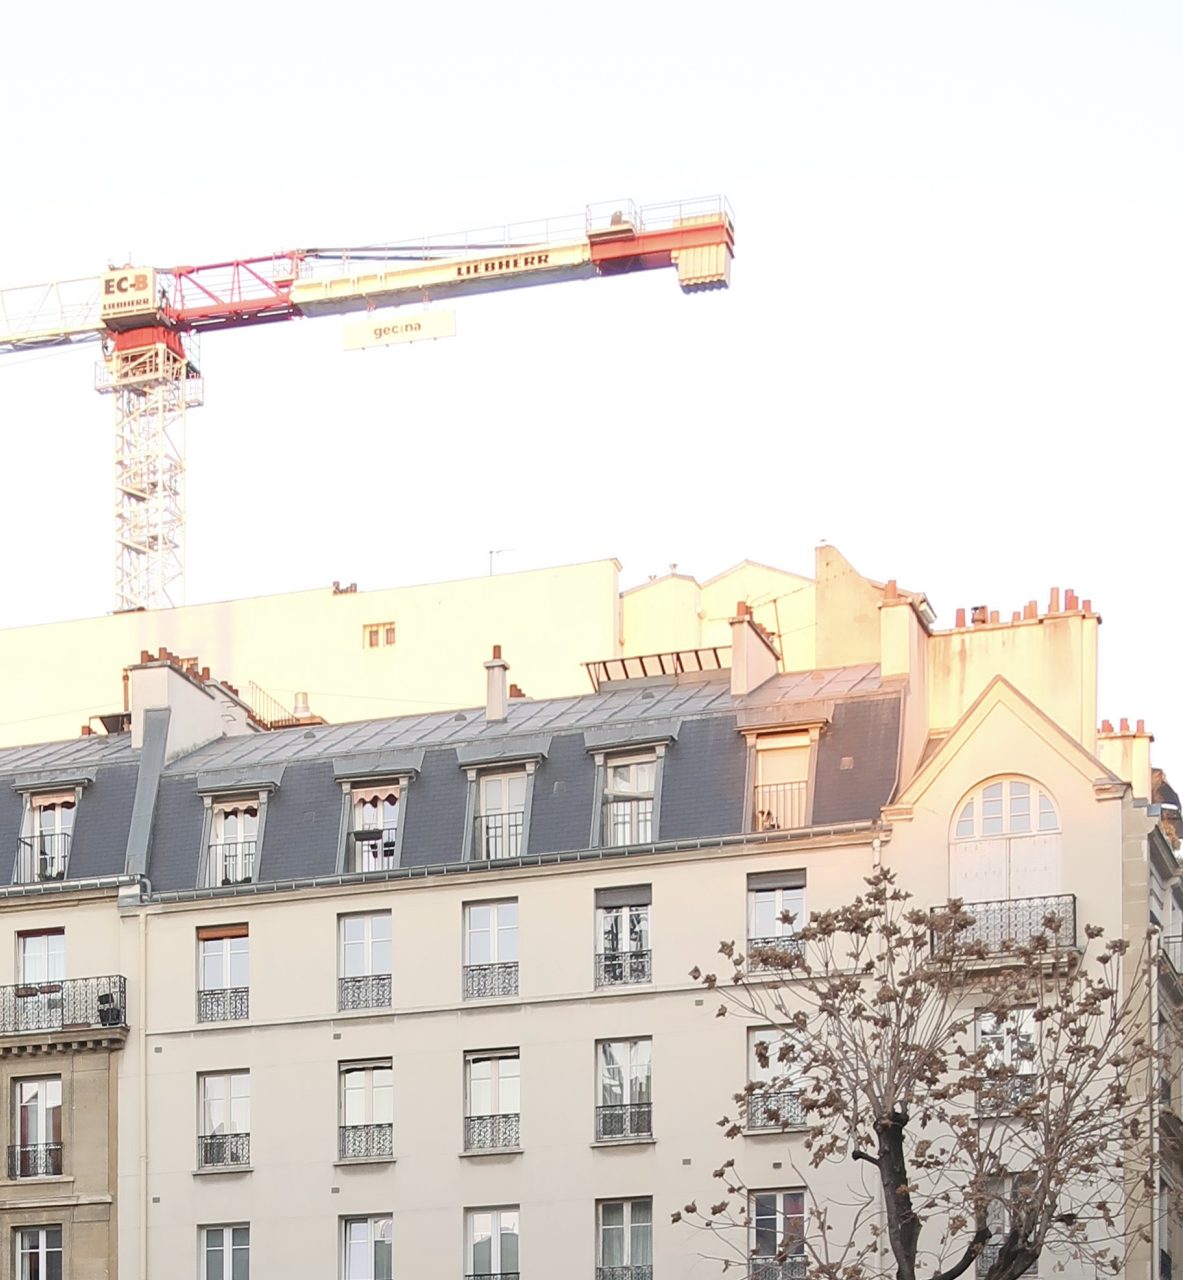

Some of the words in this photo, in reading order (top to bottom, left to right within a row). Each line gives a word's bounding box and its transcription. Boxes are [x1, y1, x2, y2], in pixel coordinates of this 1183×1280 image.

[456, 254, 550, 276] LIEBHERR
[104, 274, 149, 296] EC-B
[373, 322, 422, 340] gecina
